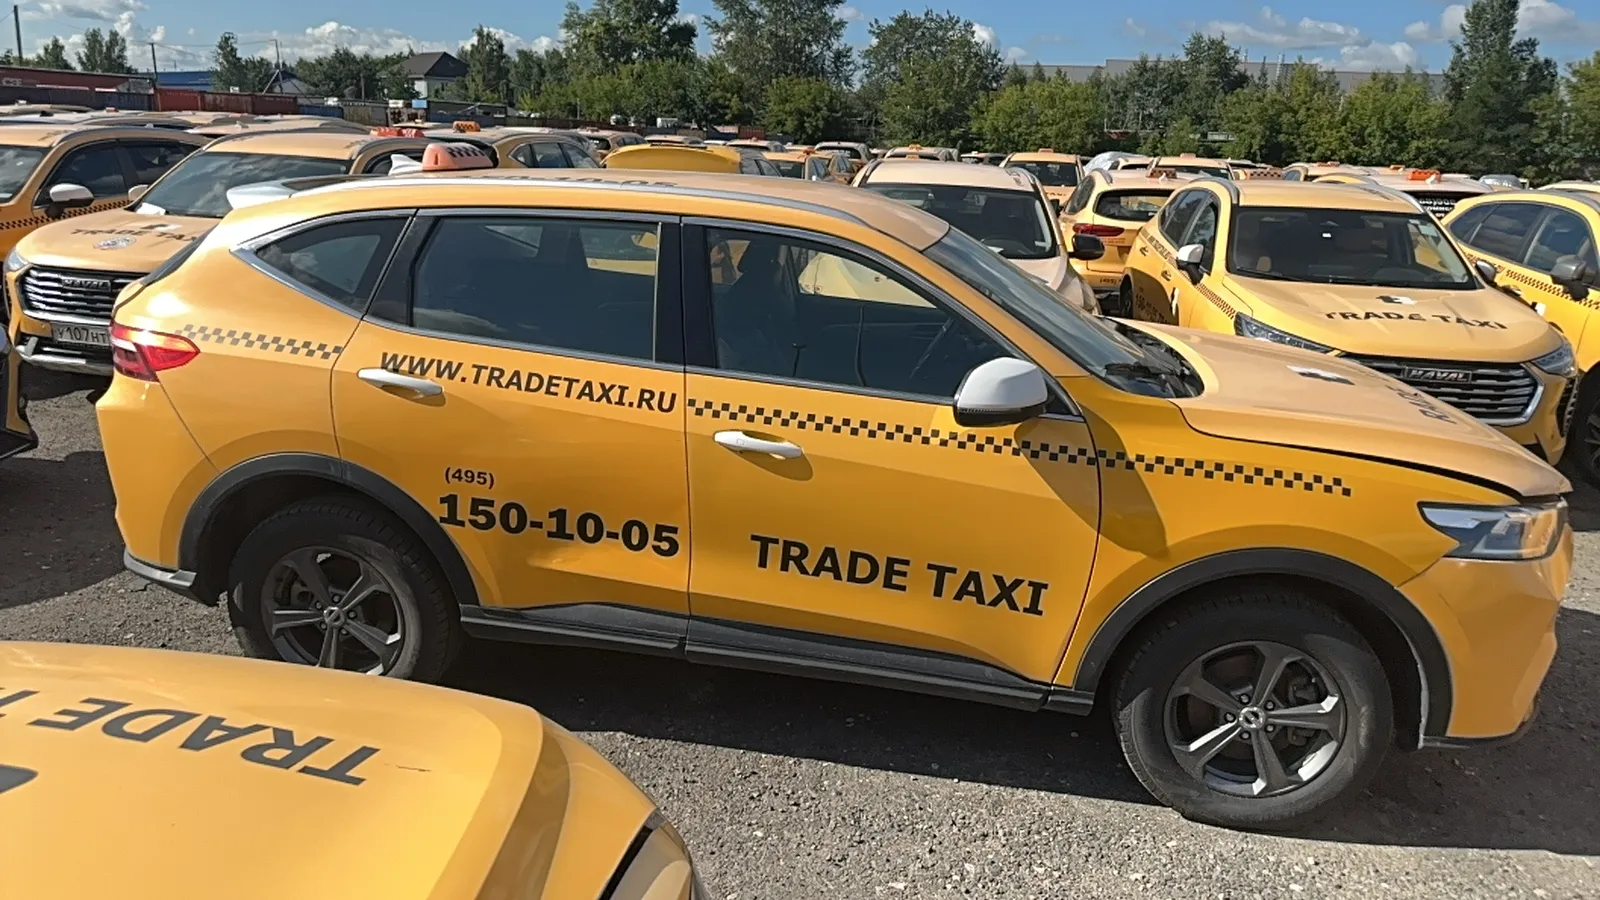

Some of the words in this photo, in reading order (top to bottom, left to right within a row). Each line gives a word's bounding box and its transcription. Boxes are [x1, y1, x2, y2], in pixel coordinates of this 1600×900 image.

[1325, 311, 1427, 322] TRADE
[1431, 314, 1508, 330] TAXI
[380, 351, 677, 414] WWW.TRADETAXI.RU
[1408, 368, 1468, 382] HAVAL
[444, 466, 496, 489] (495)
[438, 493, 680, 559] 150-10-05
[750, 533, 911, 592] TRADE
[926, 562, 1049, 617] TAXI
[26, 697, 381, 786] TRADE
